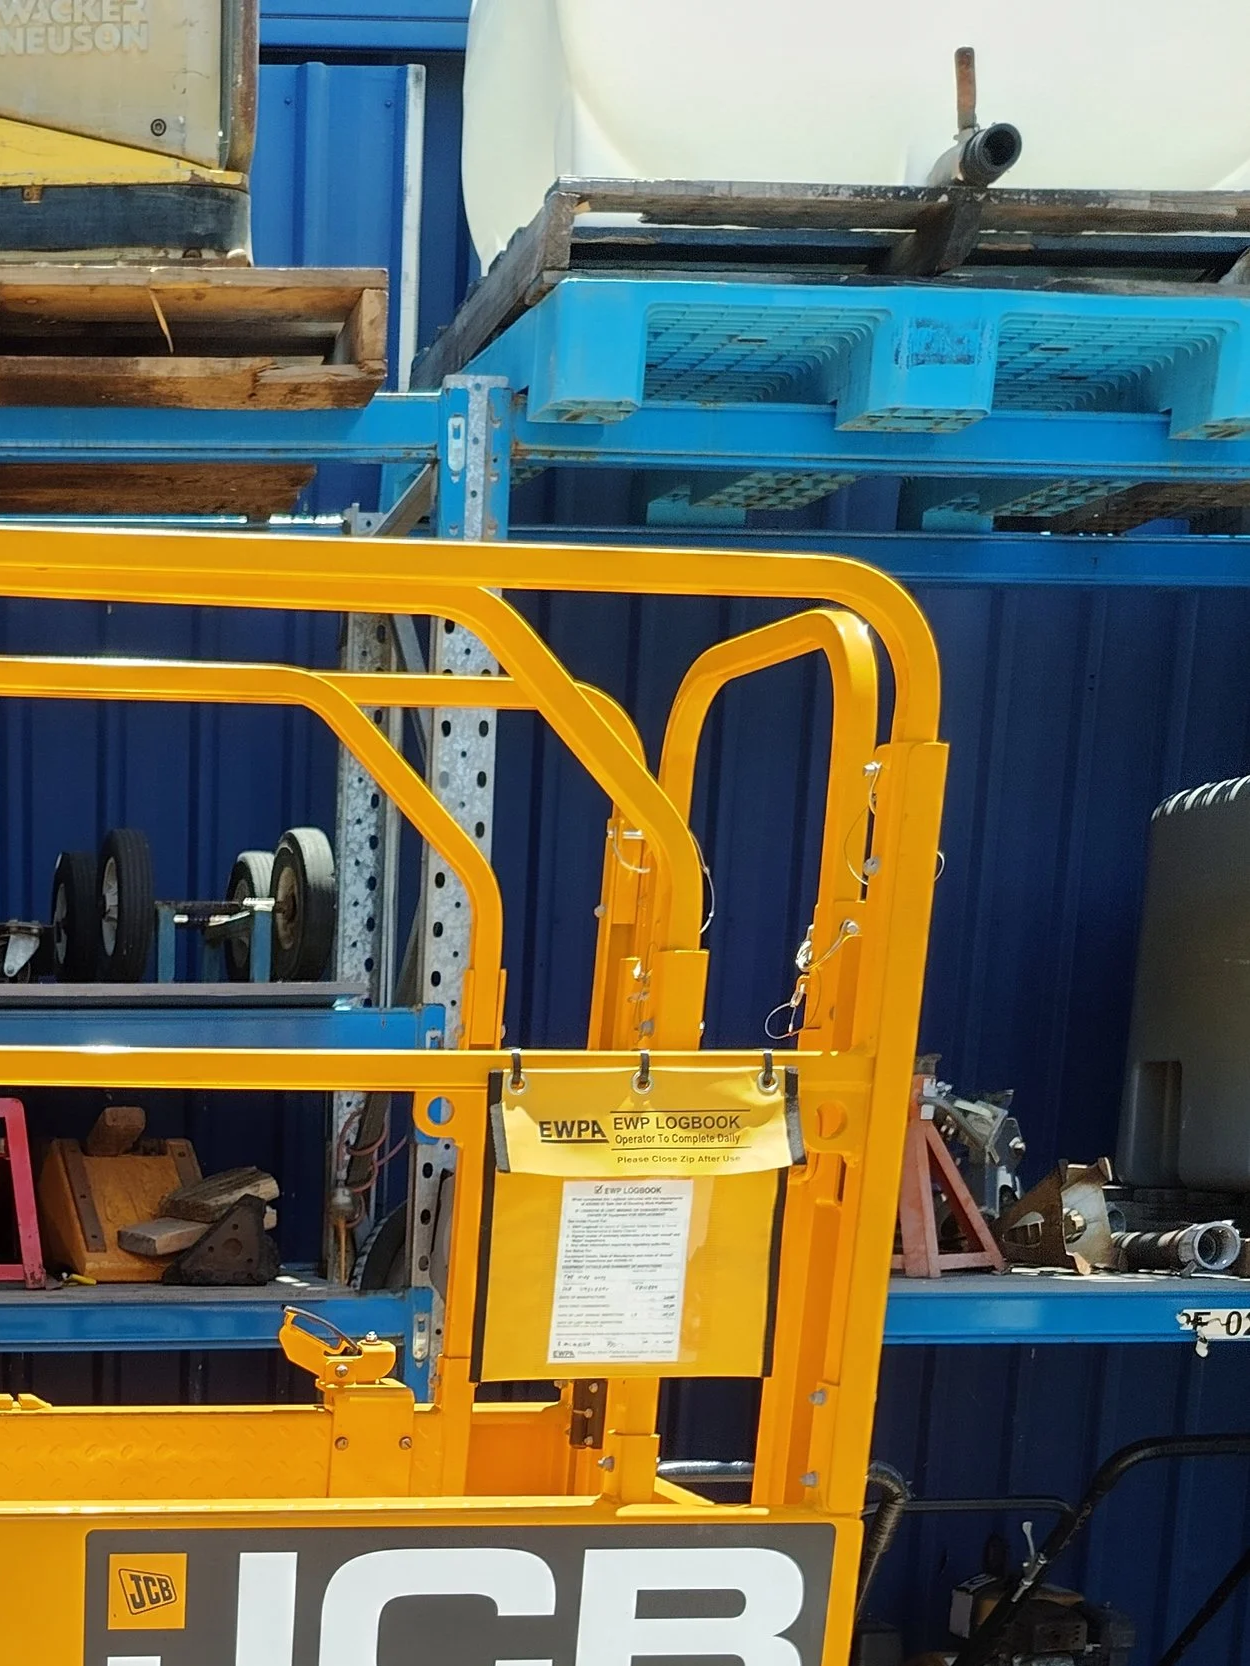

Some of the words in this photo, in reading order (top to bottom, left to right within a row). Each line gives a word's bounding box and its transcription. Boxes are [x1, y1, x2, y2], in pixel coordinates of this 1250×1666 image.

[538, 1119, 607, 1139] EWPA
[613, 1117, 650, 1131] EWP
[655, 1115, 741, 1130] LOGBOOK
[615, 1134, 655, 1146] Operator
[658, 1134, 670, 1143] To
[672, 1133, 715, 1145] Complete
[717, 1133, 741, 1144] Daily
[680, 1155, 695, 1163] Zip
[604, 1187, 622, 1195] EWP
[623, 1186, 662, 1194] LOGBOOK
[128, 1572, 175, 1611] JCB
